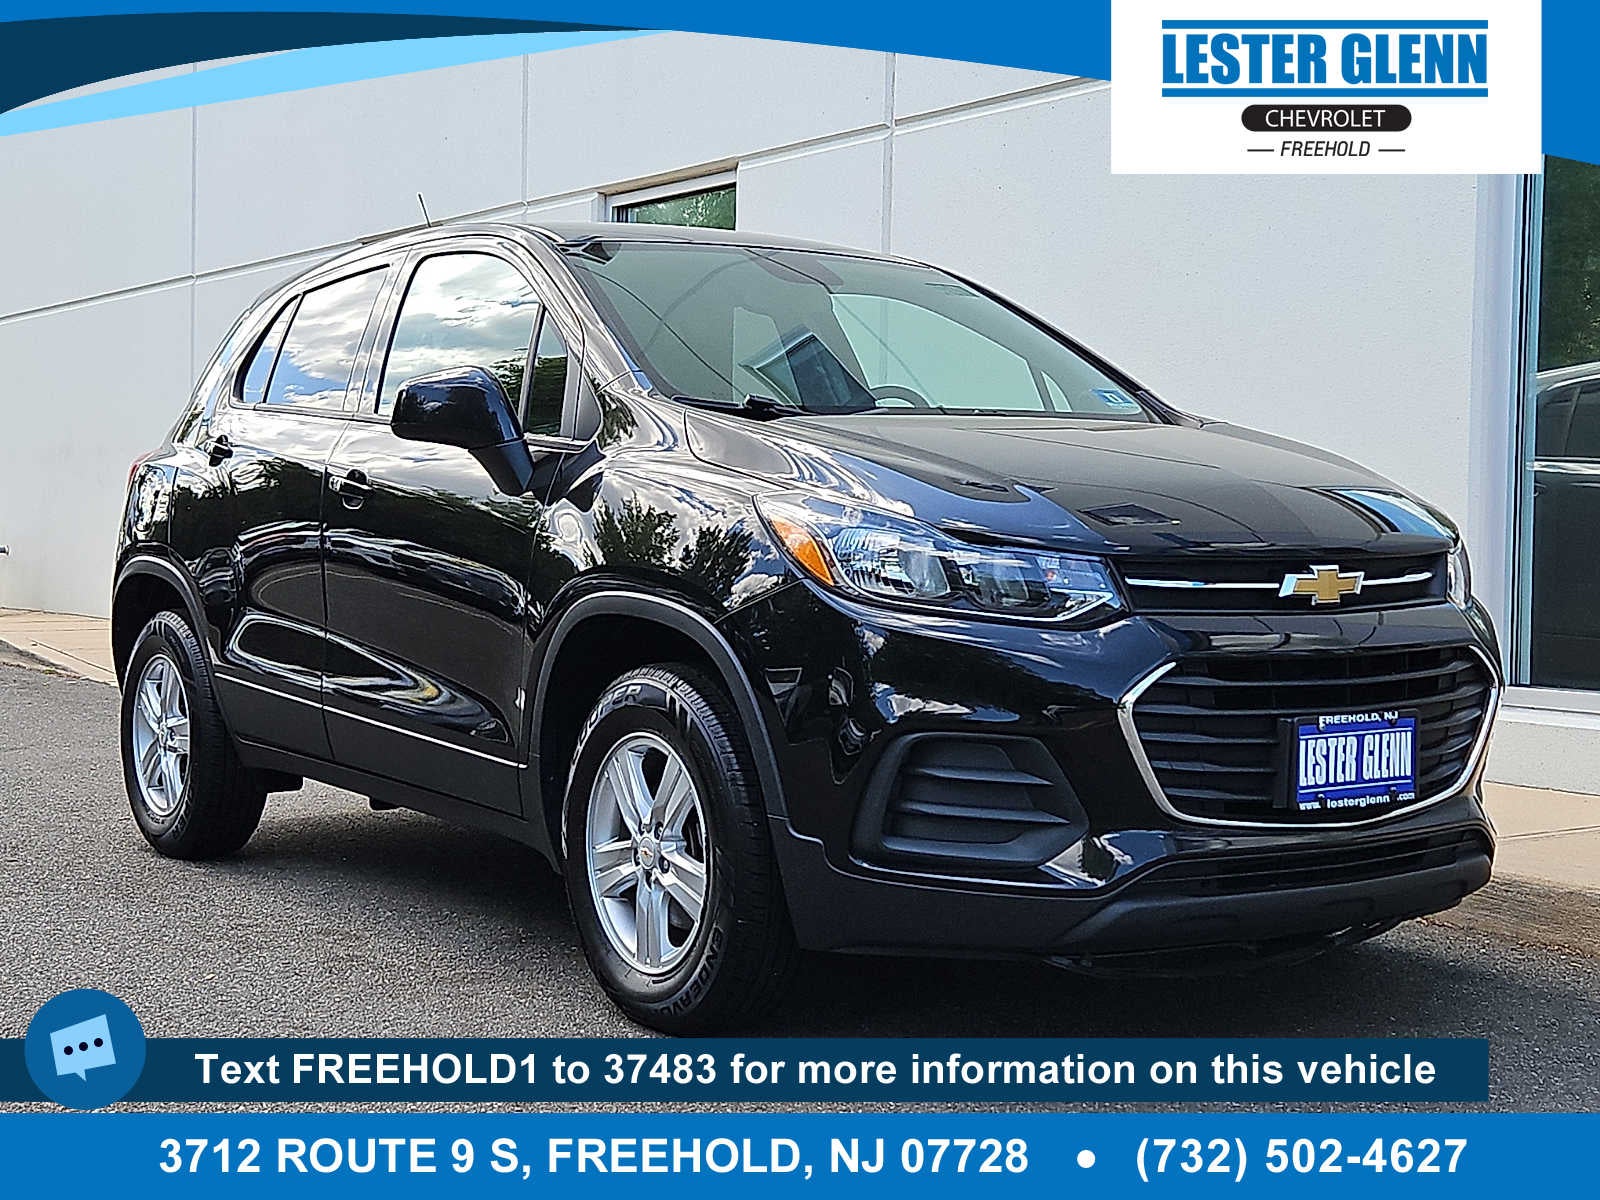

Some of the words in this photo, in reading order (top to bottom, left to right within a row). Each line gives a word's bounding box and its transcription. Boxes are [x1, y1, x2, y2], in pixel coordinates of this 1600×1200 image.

[1318, 713, 1382, 725] FREEHOLD,
[1384, 711, 1399, 721] NJ
[1300, 736, 1357, 786] LESTER
[1362, 732, 1412, 781] GLENN
